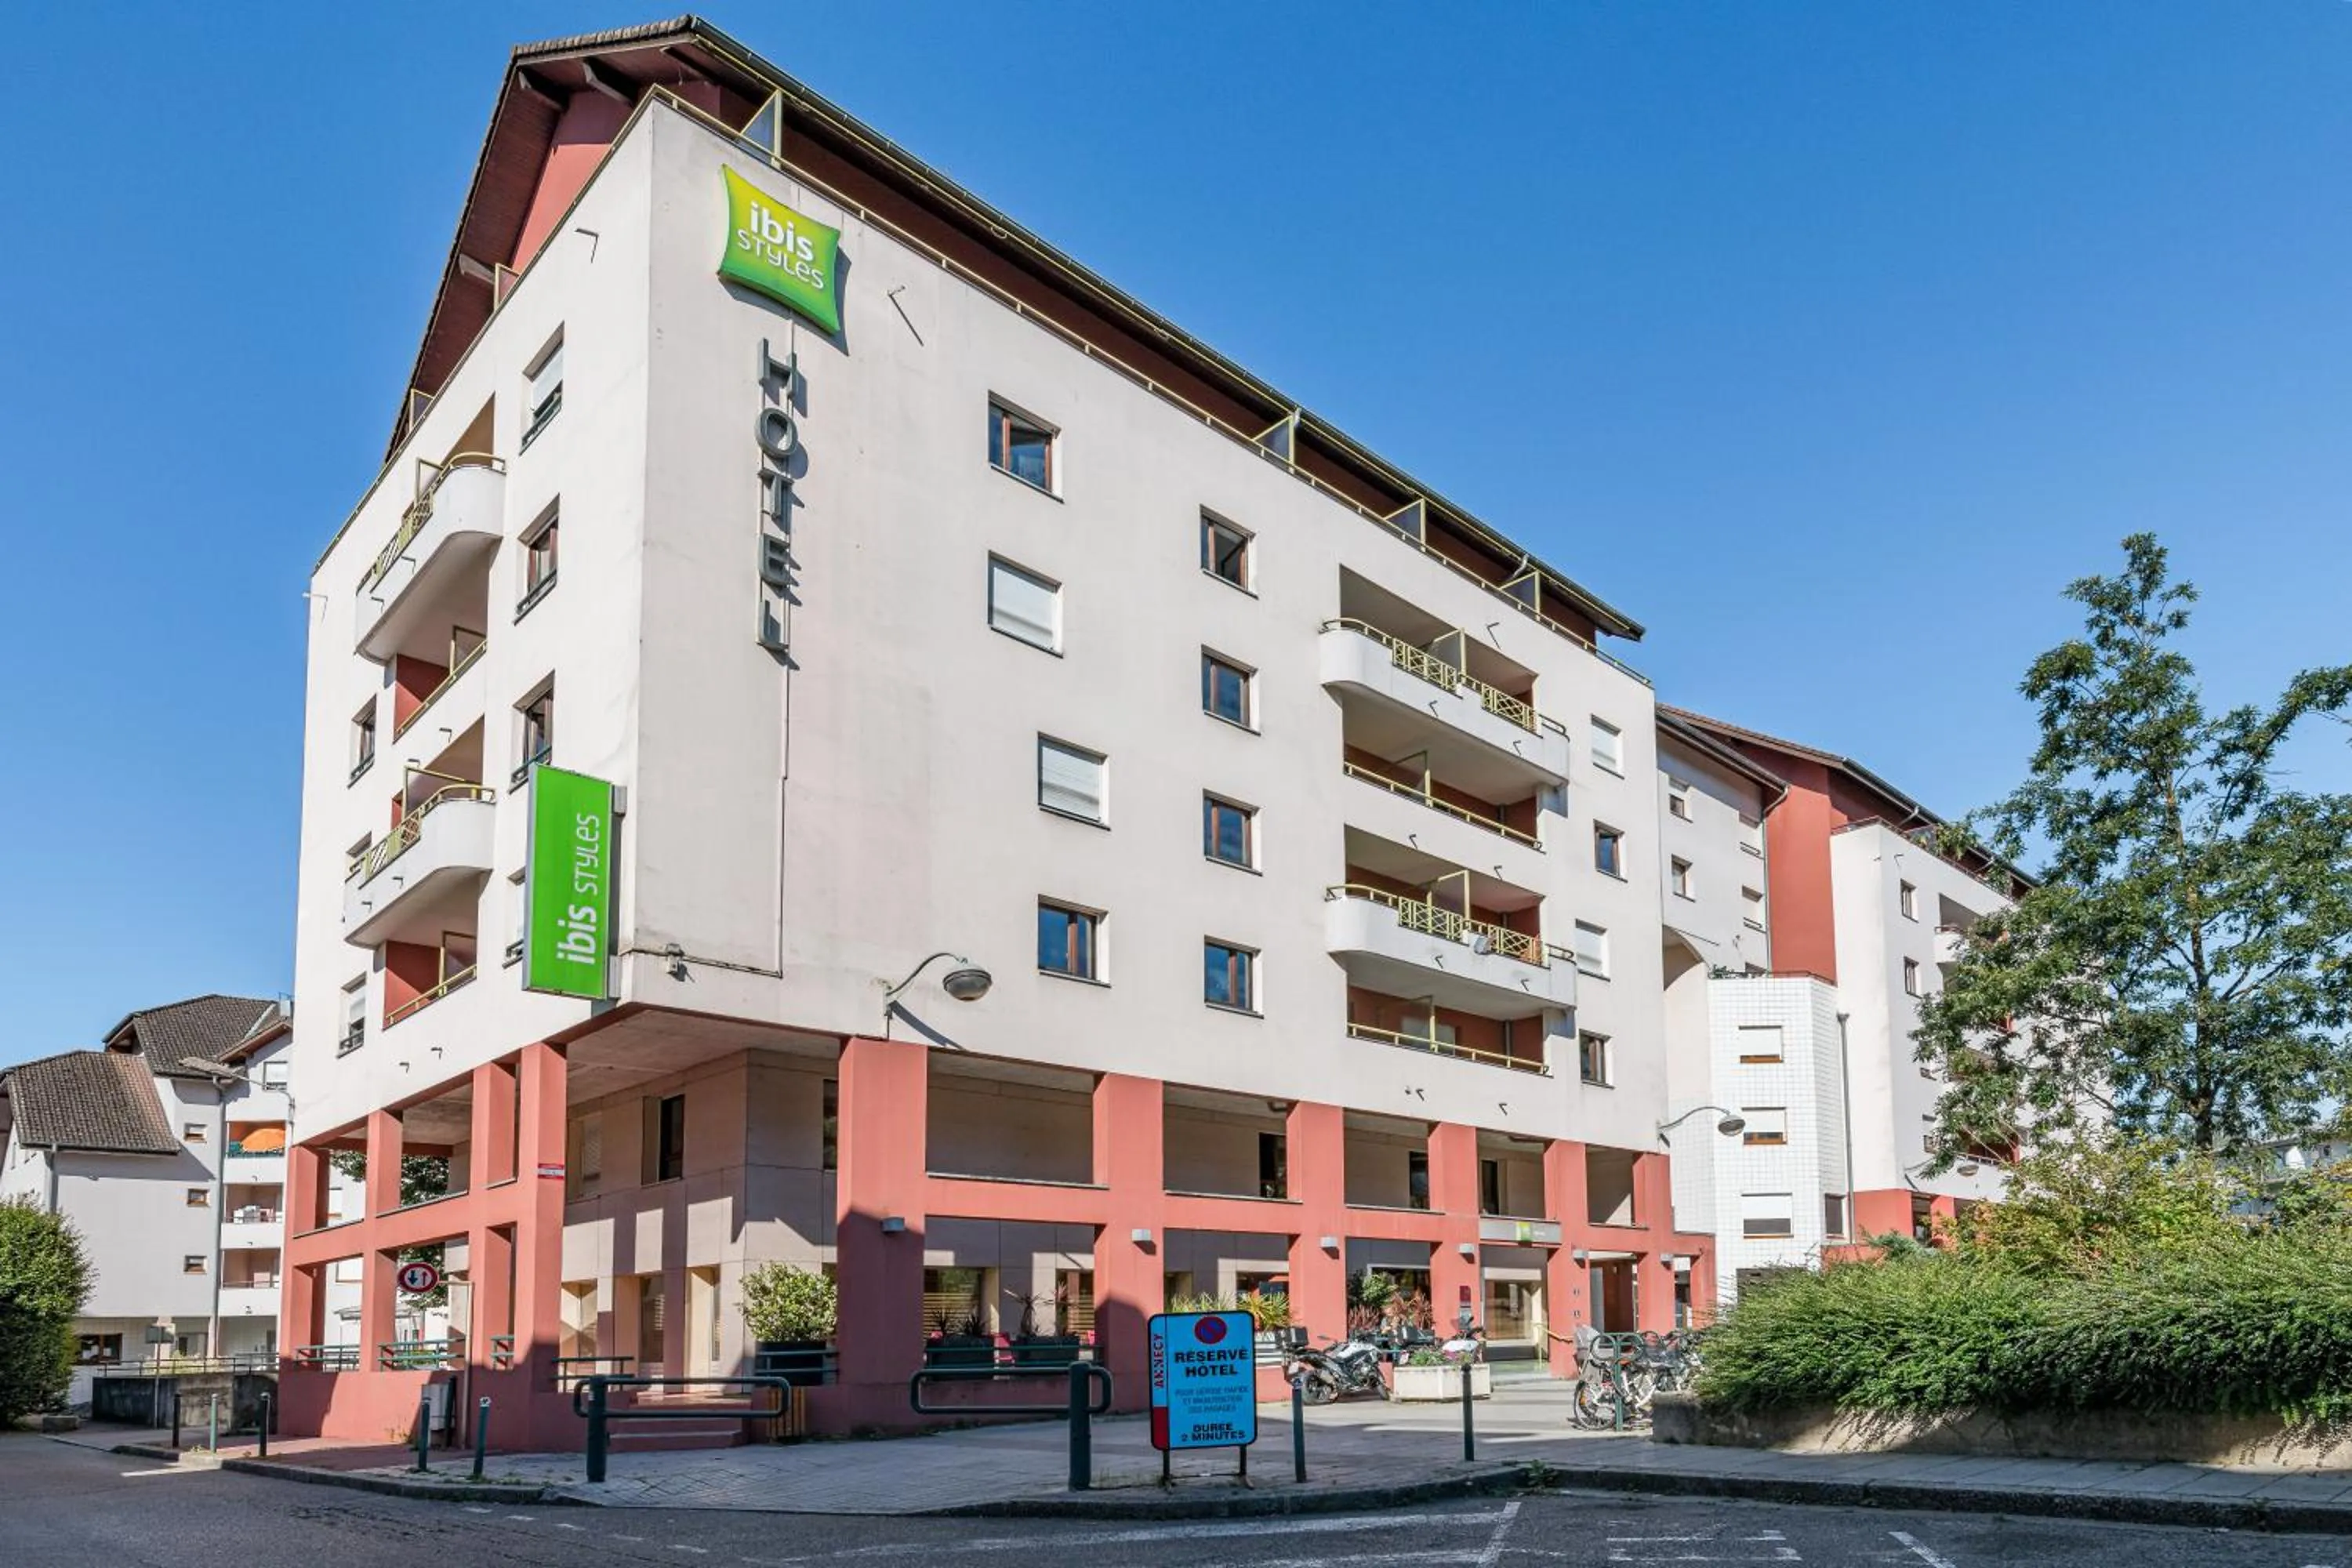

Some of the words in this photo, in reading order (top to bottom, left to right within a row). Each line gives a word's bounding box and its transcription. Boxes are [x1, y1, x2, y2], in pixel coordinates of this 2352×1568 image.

[750, 201, 814, 262] ibis
[755, 338, 798, 649] HOTEL
[556, 904, 597, 965] ibis
[1153, 1334, 1164, 1388] ANNECY
[1181, 1432, 1188, 1442] 2
[1192, 1429, 1247, 1442] MINUTES
